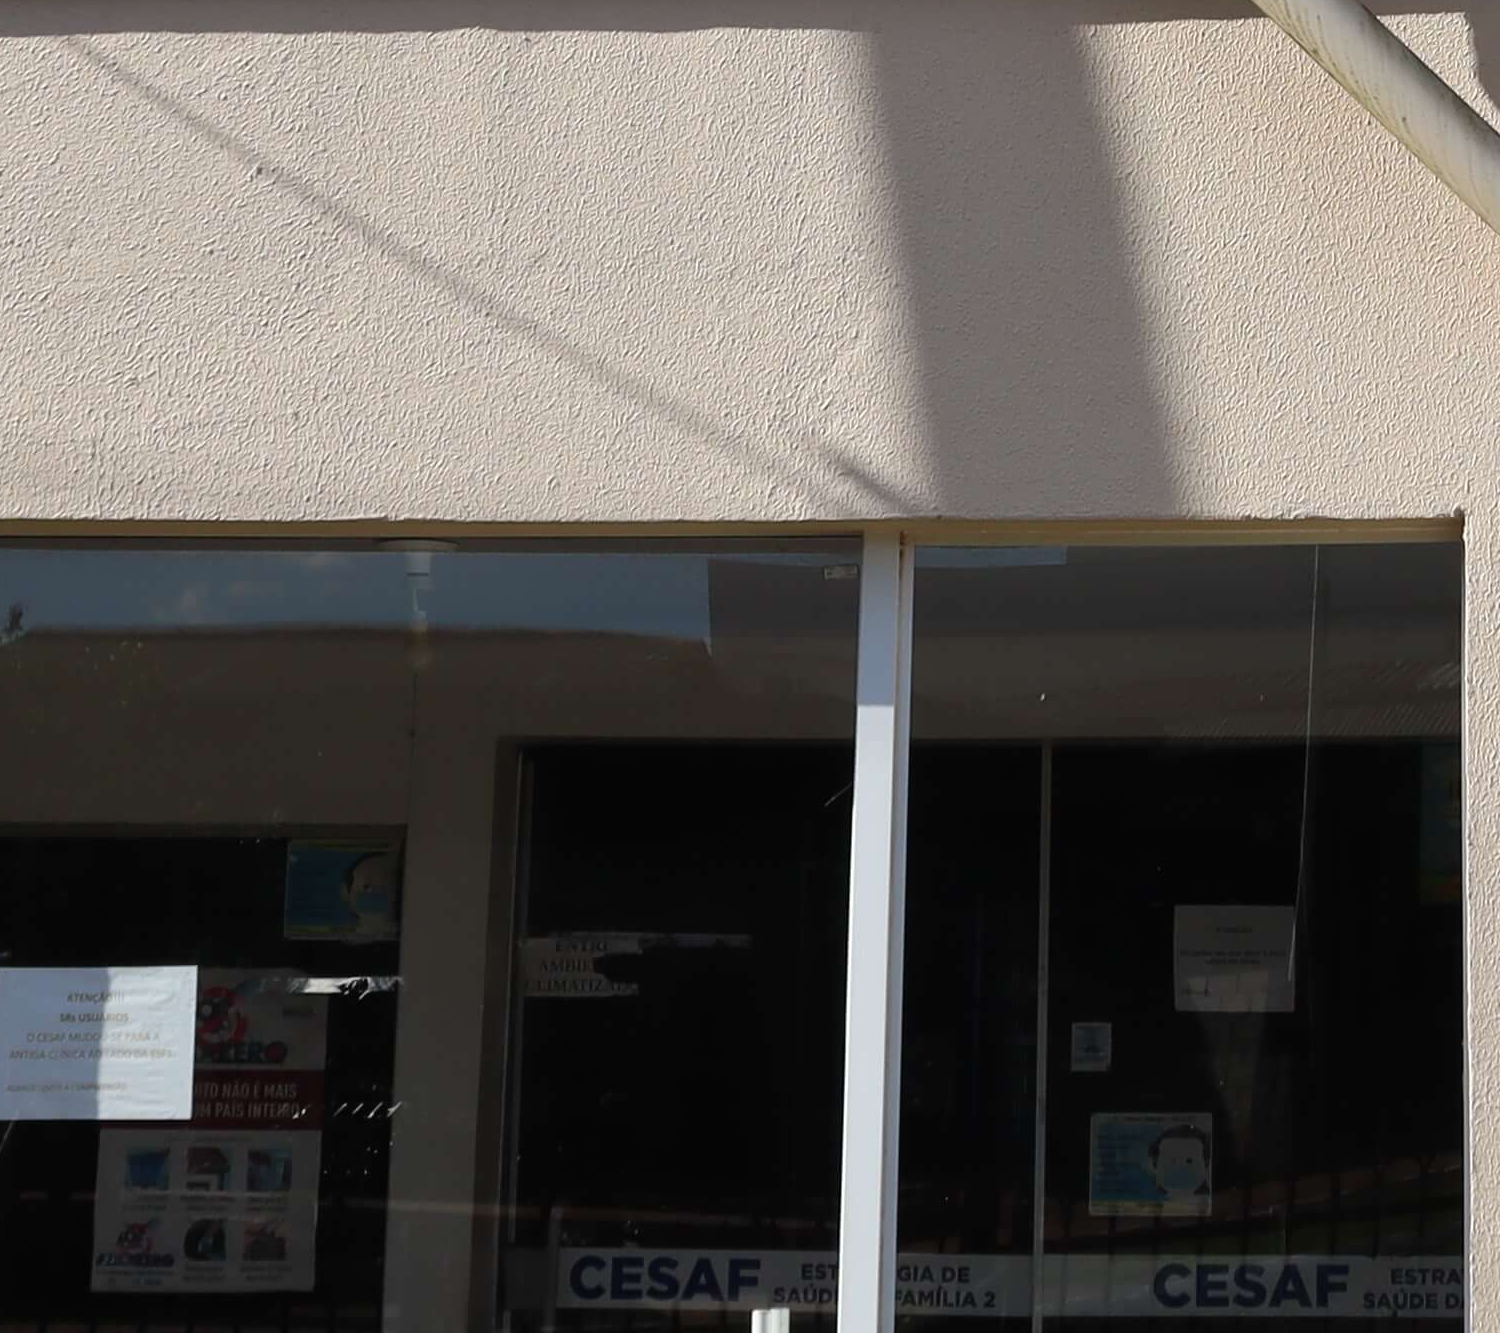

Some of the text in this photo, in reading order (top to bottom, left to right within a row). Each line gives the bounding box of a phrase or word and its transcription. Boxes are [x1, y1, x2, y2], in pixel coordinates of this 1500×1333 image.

[539, 958, 597, 973] AMBIE
[221, 1077, 251, 1099] NÃO
[263, 1082, 298, 1099] MAIS
[214, 1099, 244, 1118] PAÍS
[569, 1255, 762, 1302] CESAF
[800, 1263, 972, 1284] ESTGIA DE
[1390, 1268, 1464, 1286] ESTRA
[772, 1282, 837, 1305] SAÚD
[983, 1291, 996, 1308] 2
[1153, 1263, 1350, 1309] CESAF
[1363, 1287, 1464, 1310] SAÚDE D
